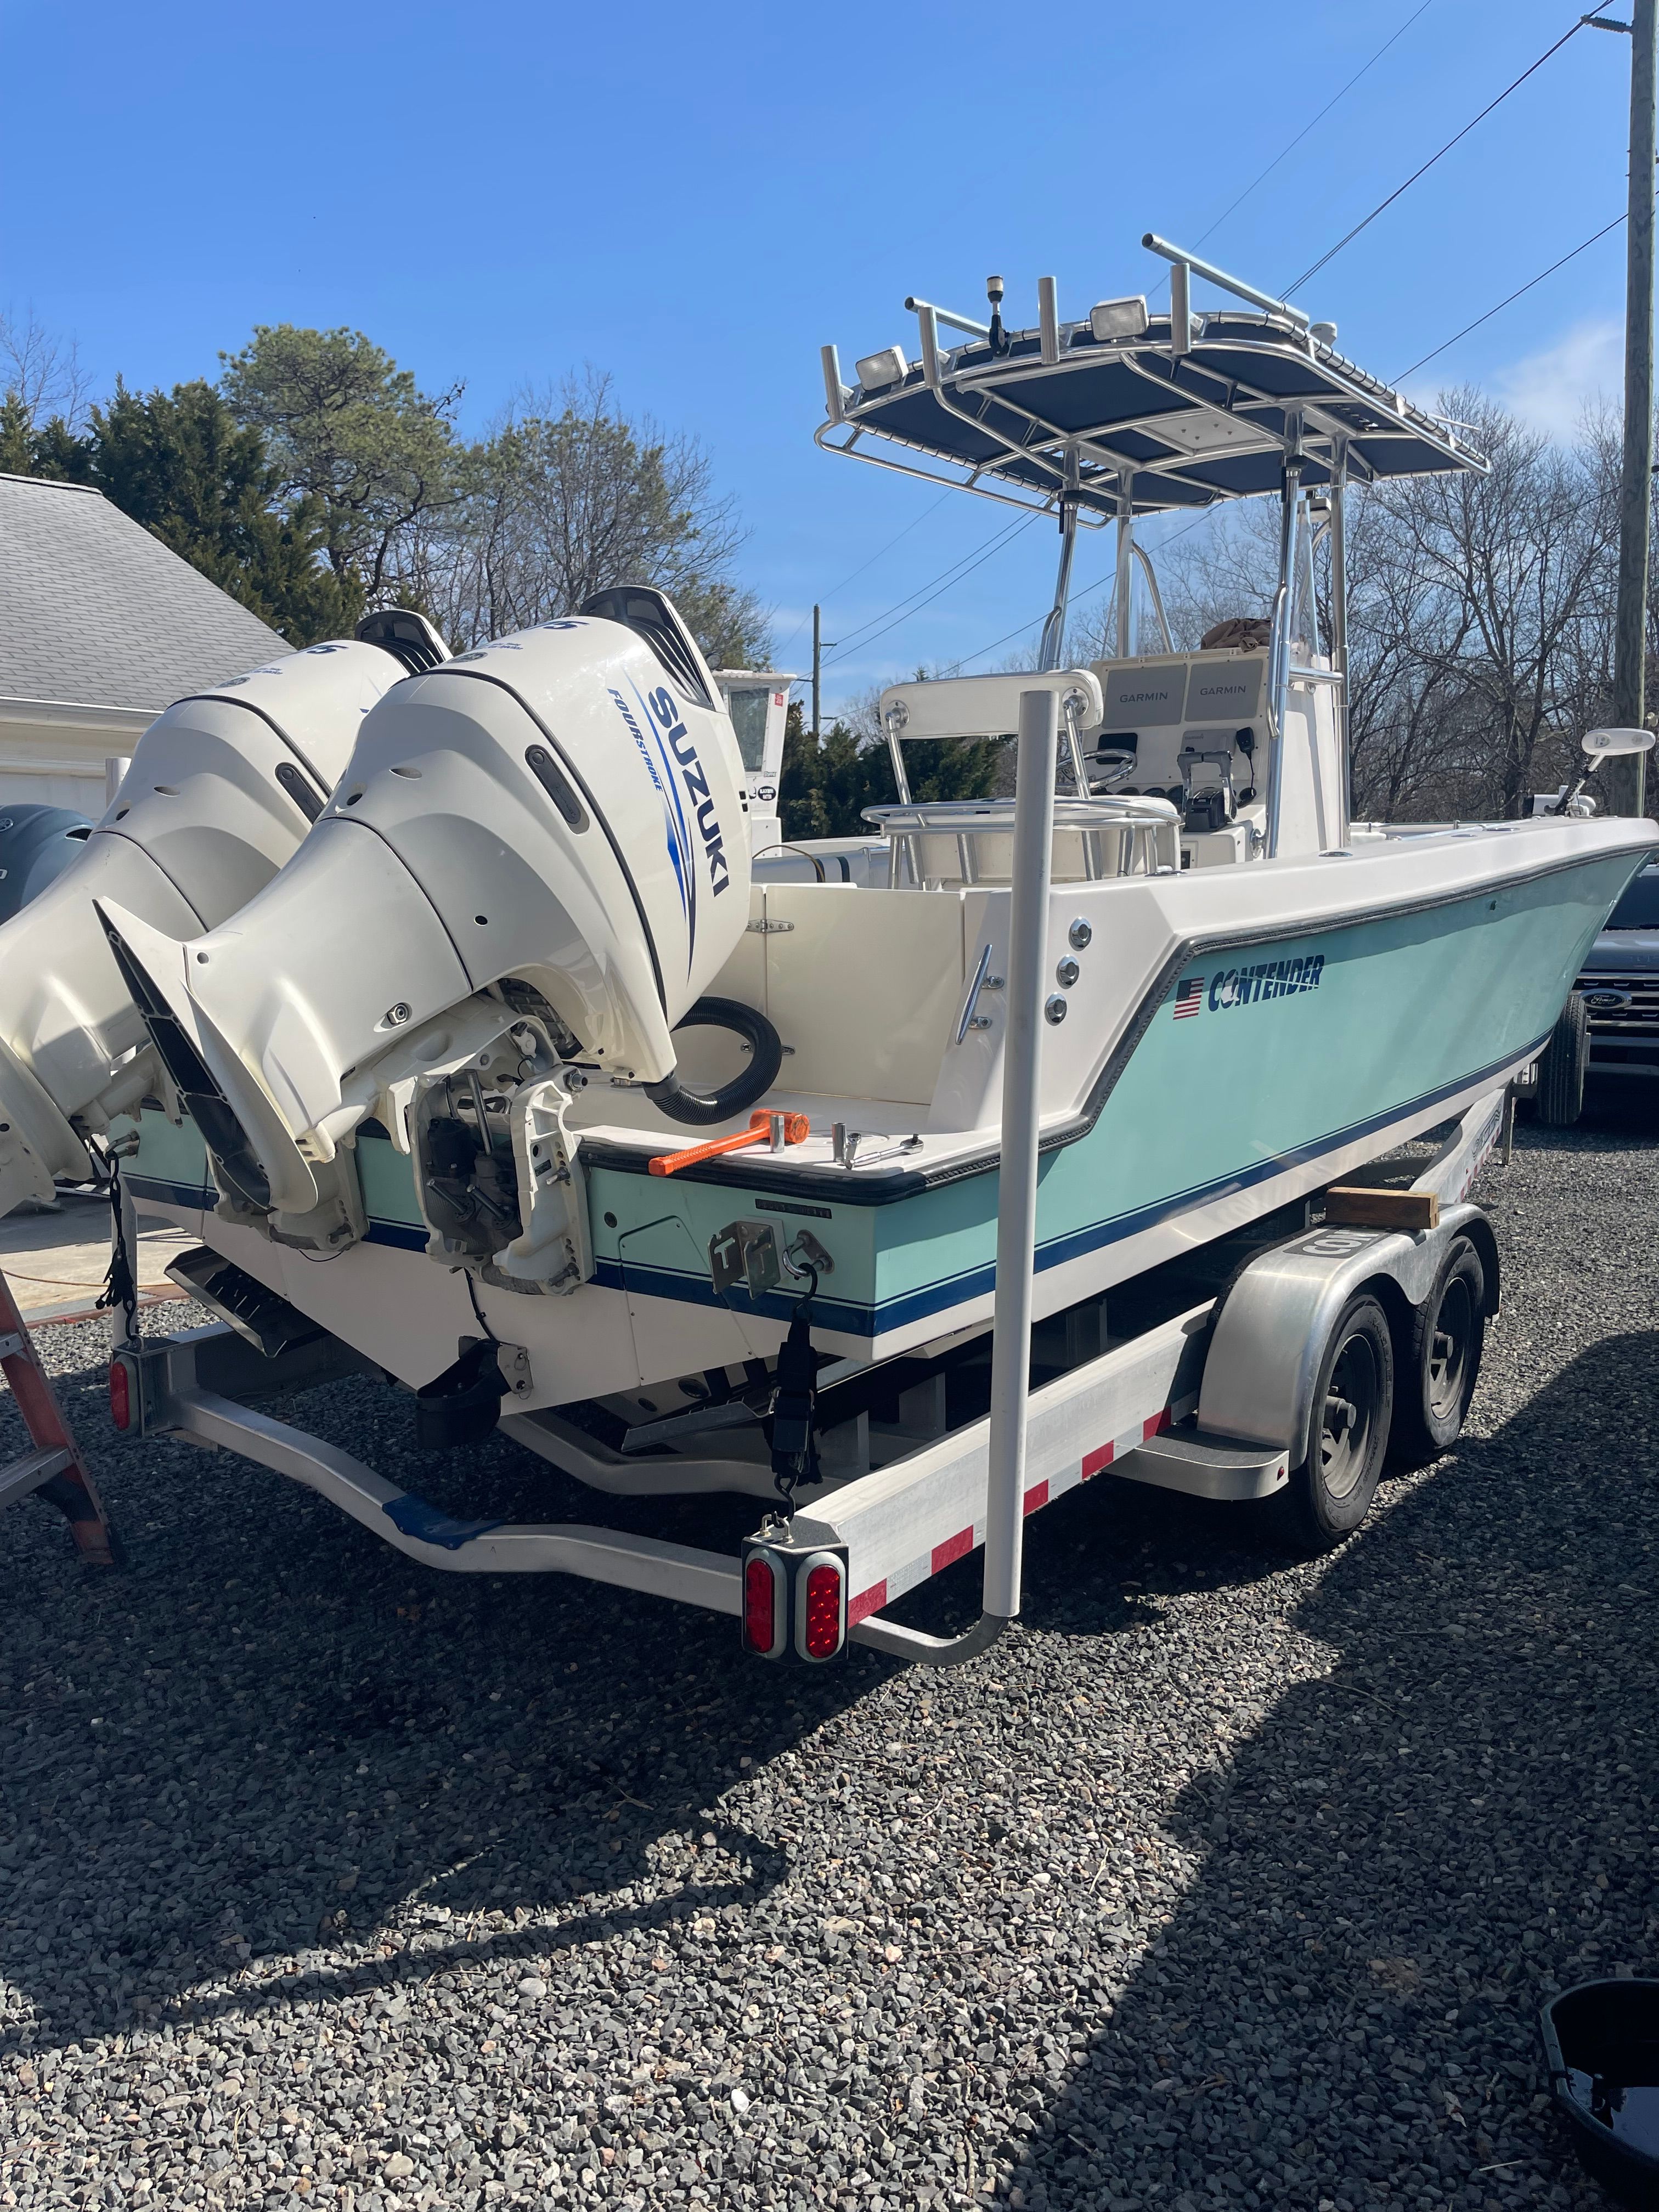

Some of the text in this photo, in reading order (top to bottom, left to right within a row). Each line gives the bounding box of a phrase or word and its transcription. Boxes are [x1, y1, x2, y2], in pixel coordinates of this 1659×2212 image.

[1120, 692, 1168, 703] GARMIN
[1200, 685, 1246, 696] GARMIN
[606, 687, 664, 792] FOURSTROKE
[648, 686, 730, 898] SUZUKI
[1208, 955, 1325, 1012] CONTENDER
[1302, 1229, 1379, 1255] CON
